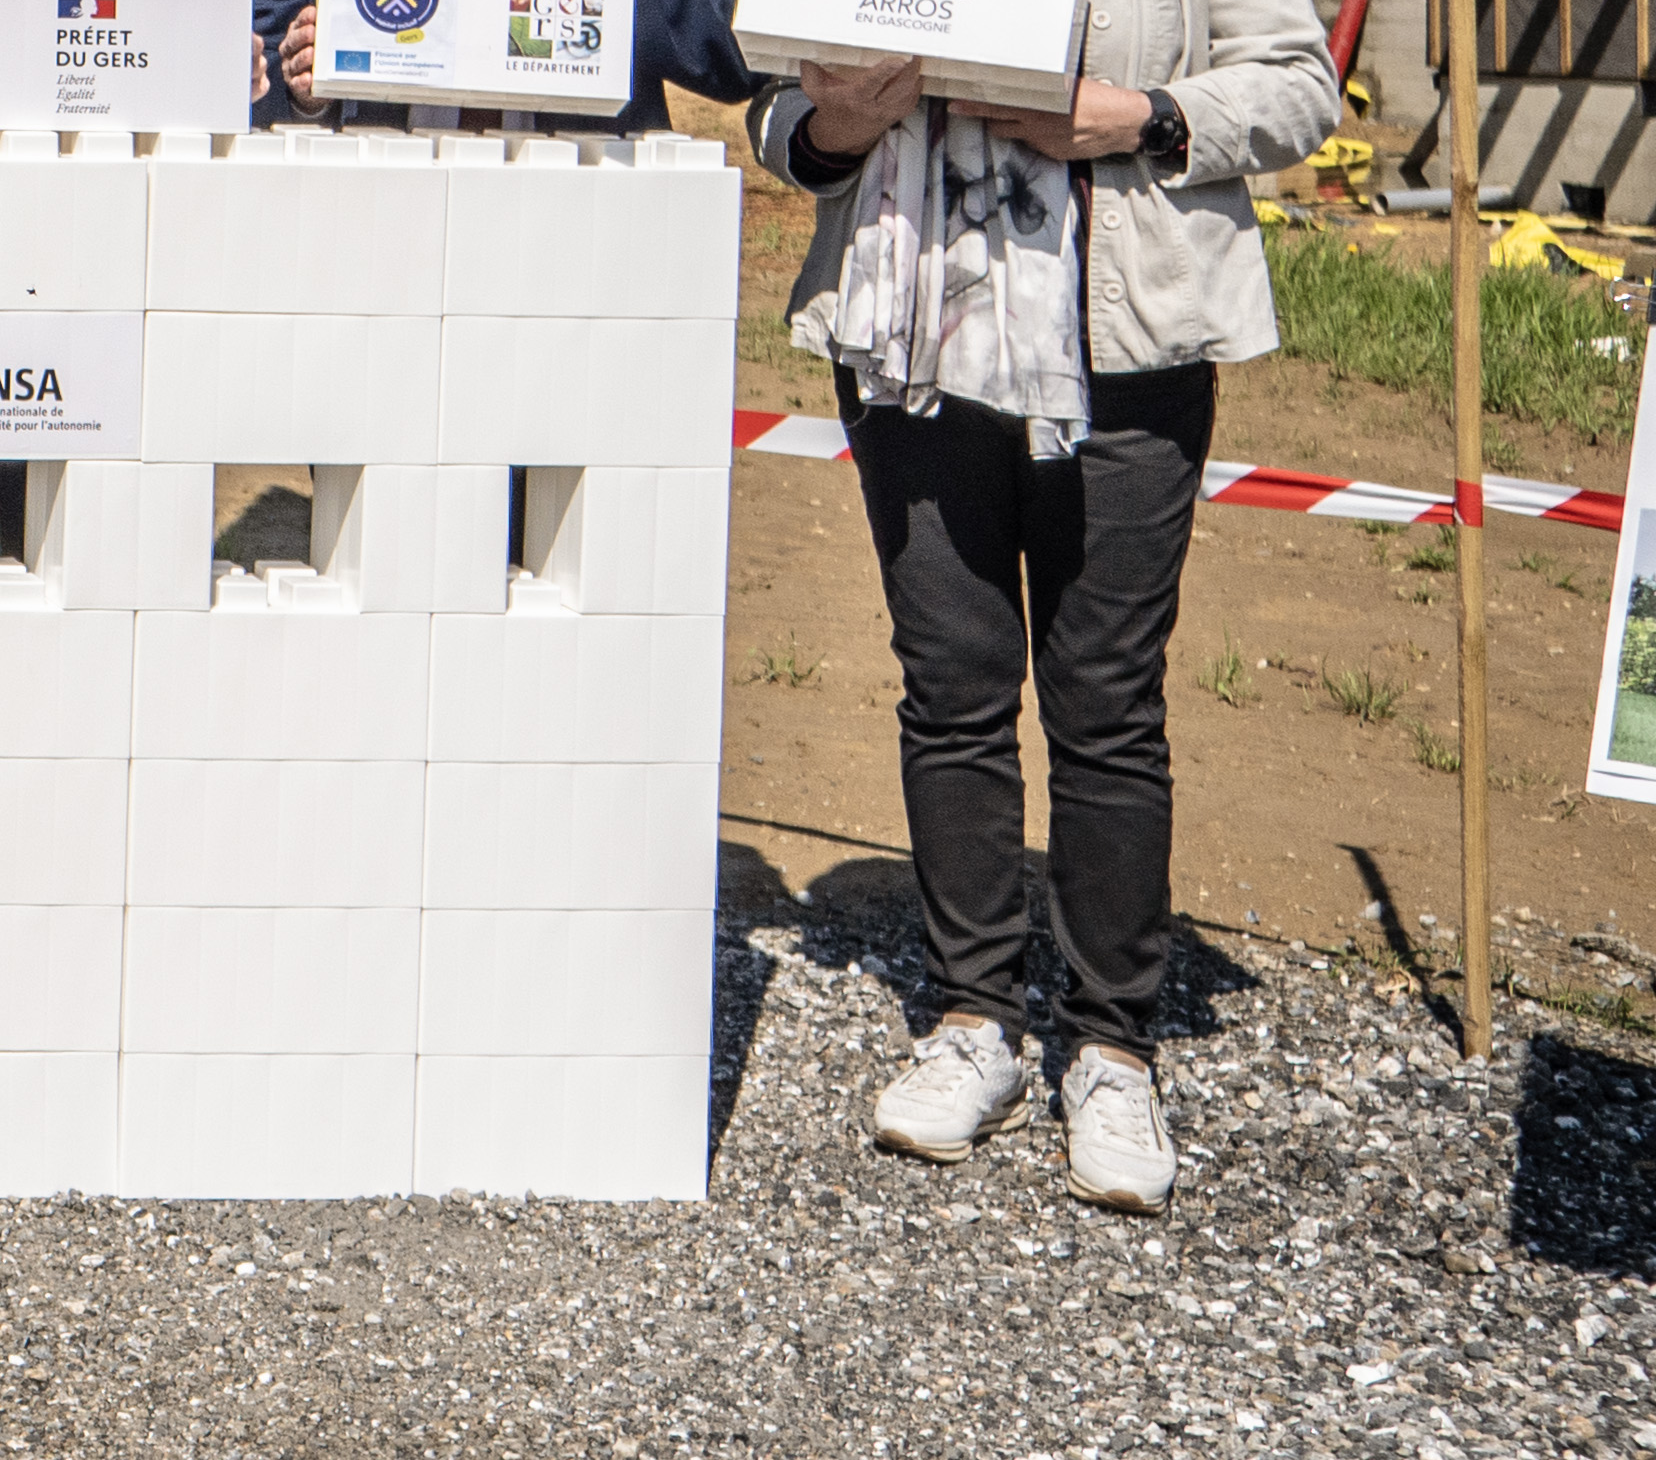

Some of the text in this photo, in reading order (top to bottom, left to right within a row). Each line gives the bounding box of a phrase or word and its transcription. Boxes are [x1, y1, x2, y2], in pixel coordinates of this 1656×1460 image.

[855, 13, 952, 34] EN GASCOGNE
[56, 26, 132, 45] PRÉFET
[56, 52, 148, 68] DU GERS
[506, 60, 600, 76] LE DÉPARTEMENT
[56, 74, 95, 85] Liberté
[56, 88, 95, 102] Égalité
[56, 103, 110, 115] Fraternité
[0, 406, 48, 417] nationale
[50, 406, 63, 417] de
[15, 422, 38, 433] pour
[41, 420, 102, 431] l'autonomie
